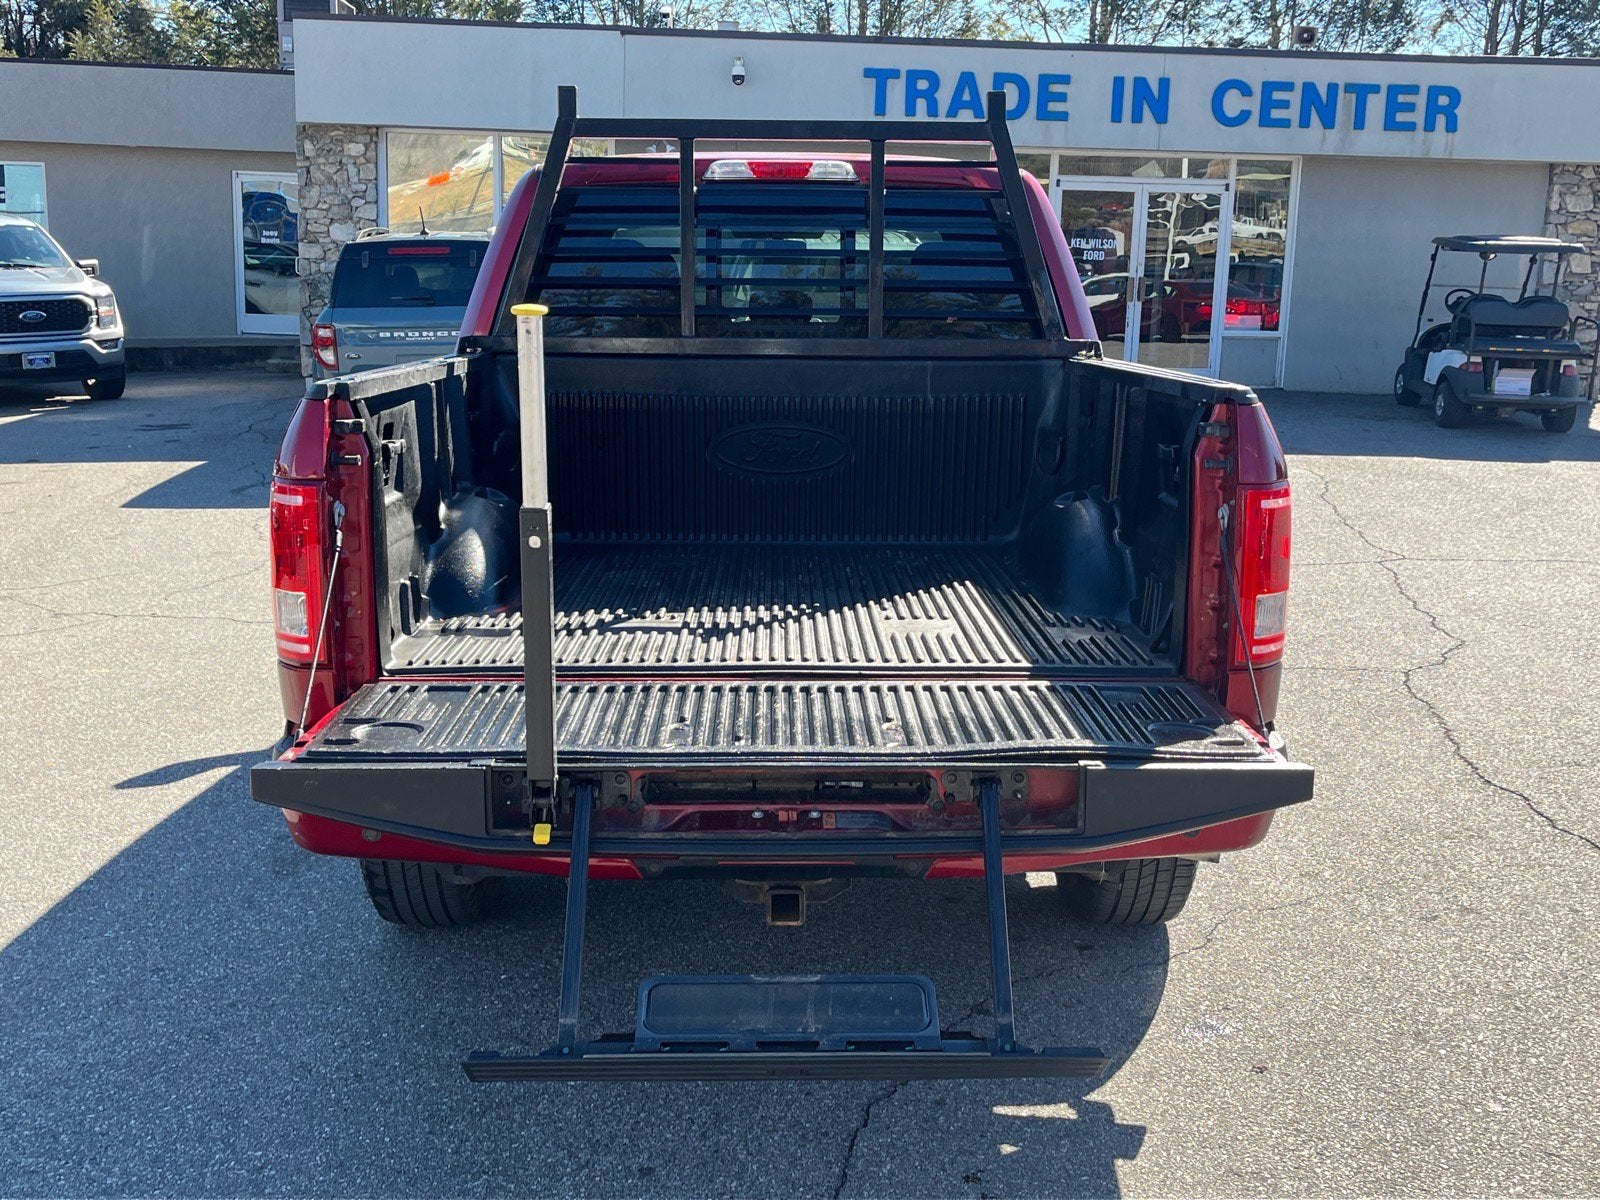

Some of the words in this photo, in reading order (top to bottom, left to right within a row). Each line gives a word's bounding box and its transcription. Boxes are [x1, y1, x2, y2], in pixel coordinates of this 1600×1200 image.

[863, 66, 1072, 122] TRADE
[1109, 74, 1172, 124] IN
[1210, 77, 1463, 133] CENTER
[1071, 238, 1087, 249] KEN
[1089, 238, 1118, 249] WILSON
[1083, 250, 1105, 261] FORD
[379, 330, 461, 338] BRONCO
[741, 429, 823, 463] Ford
